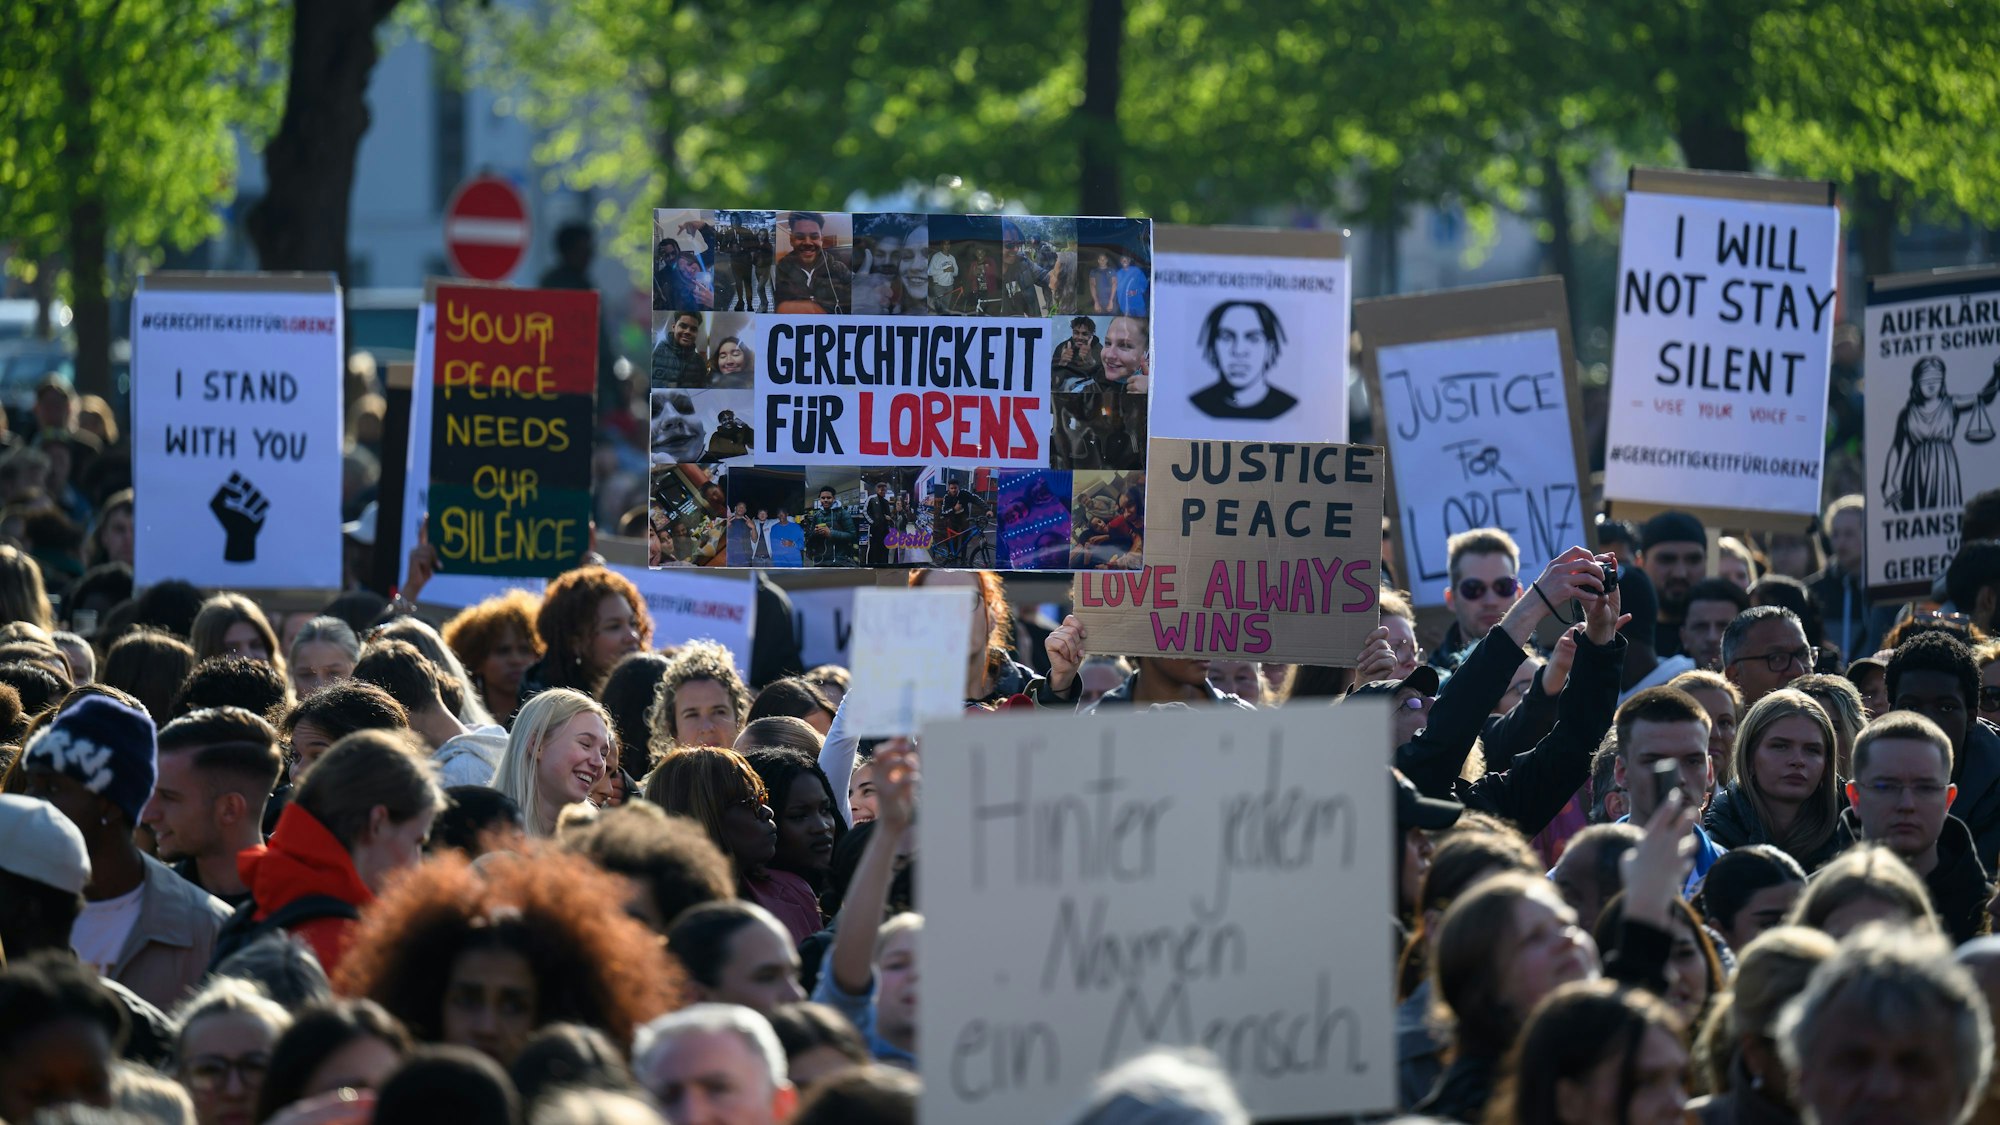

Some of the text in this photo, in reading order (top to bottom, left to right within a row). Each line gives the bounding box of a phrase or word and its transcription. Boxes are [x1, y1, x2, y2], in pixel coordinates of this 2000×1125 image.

[1675, 214, 1806, 274] I WILL
[1624, 269, 1837, 333] NOT STAY
[767, 324, 1043, 391] GERECHTIGKEIT
[1880, 327, 2000, 358] STATT SCHW
[176, 368, 298, 404] I STAND
[444, 359, 559, 400] PEACE
[1656, 340, 1805, 396] SILENT
[766, 394, 844, 455] FÜR
[1385, 369, 1560, 441] JUSTICE
[1653, 397, 1788, 425] USE YOUR VOICE
[165, 423, 307, 462] WITH YOU
[446, 412, 570, 452] NEEDS
[473, 465, 538, 509] OUR
[1171, 442, 1374, 484] JUSTICE
[440, 506, 577, 564] SILENCE
[1181, 498, 1353, 538] PEACE
[1882, 512, 1962, 541] TRANS
[1082, 556, 1376, 614] LOVE ALWAYS
[1150, 611, 1272, 653] WINS
[969, 726, 1357, 922] Hinter jedem
[1039, 895, 1247, 996] Namen
[949, 974, 1061, 1102] ein
